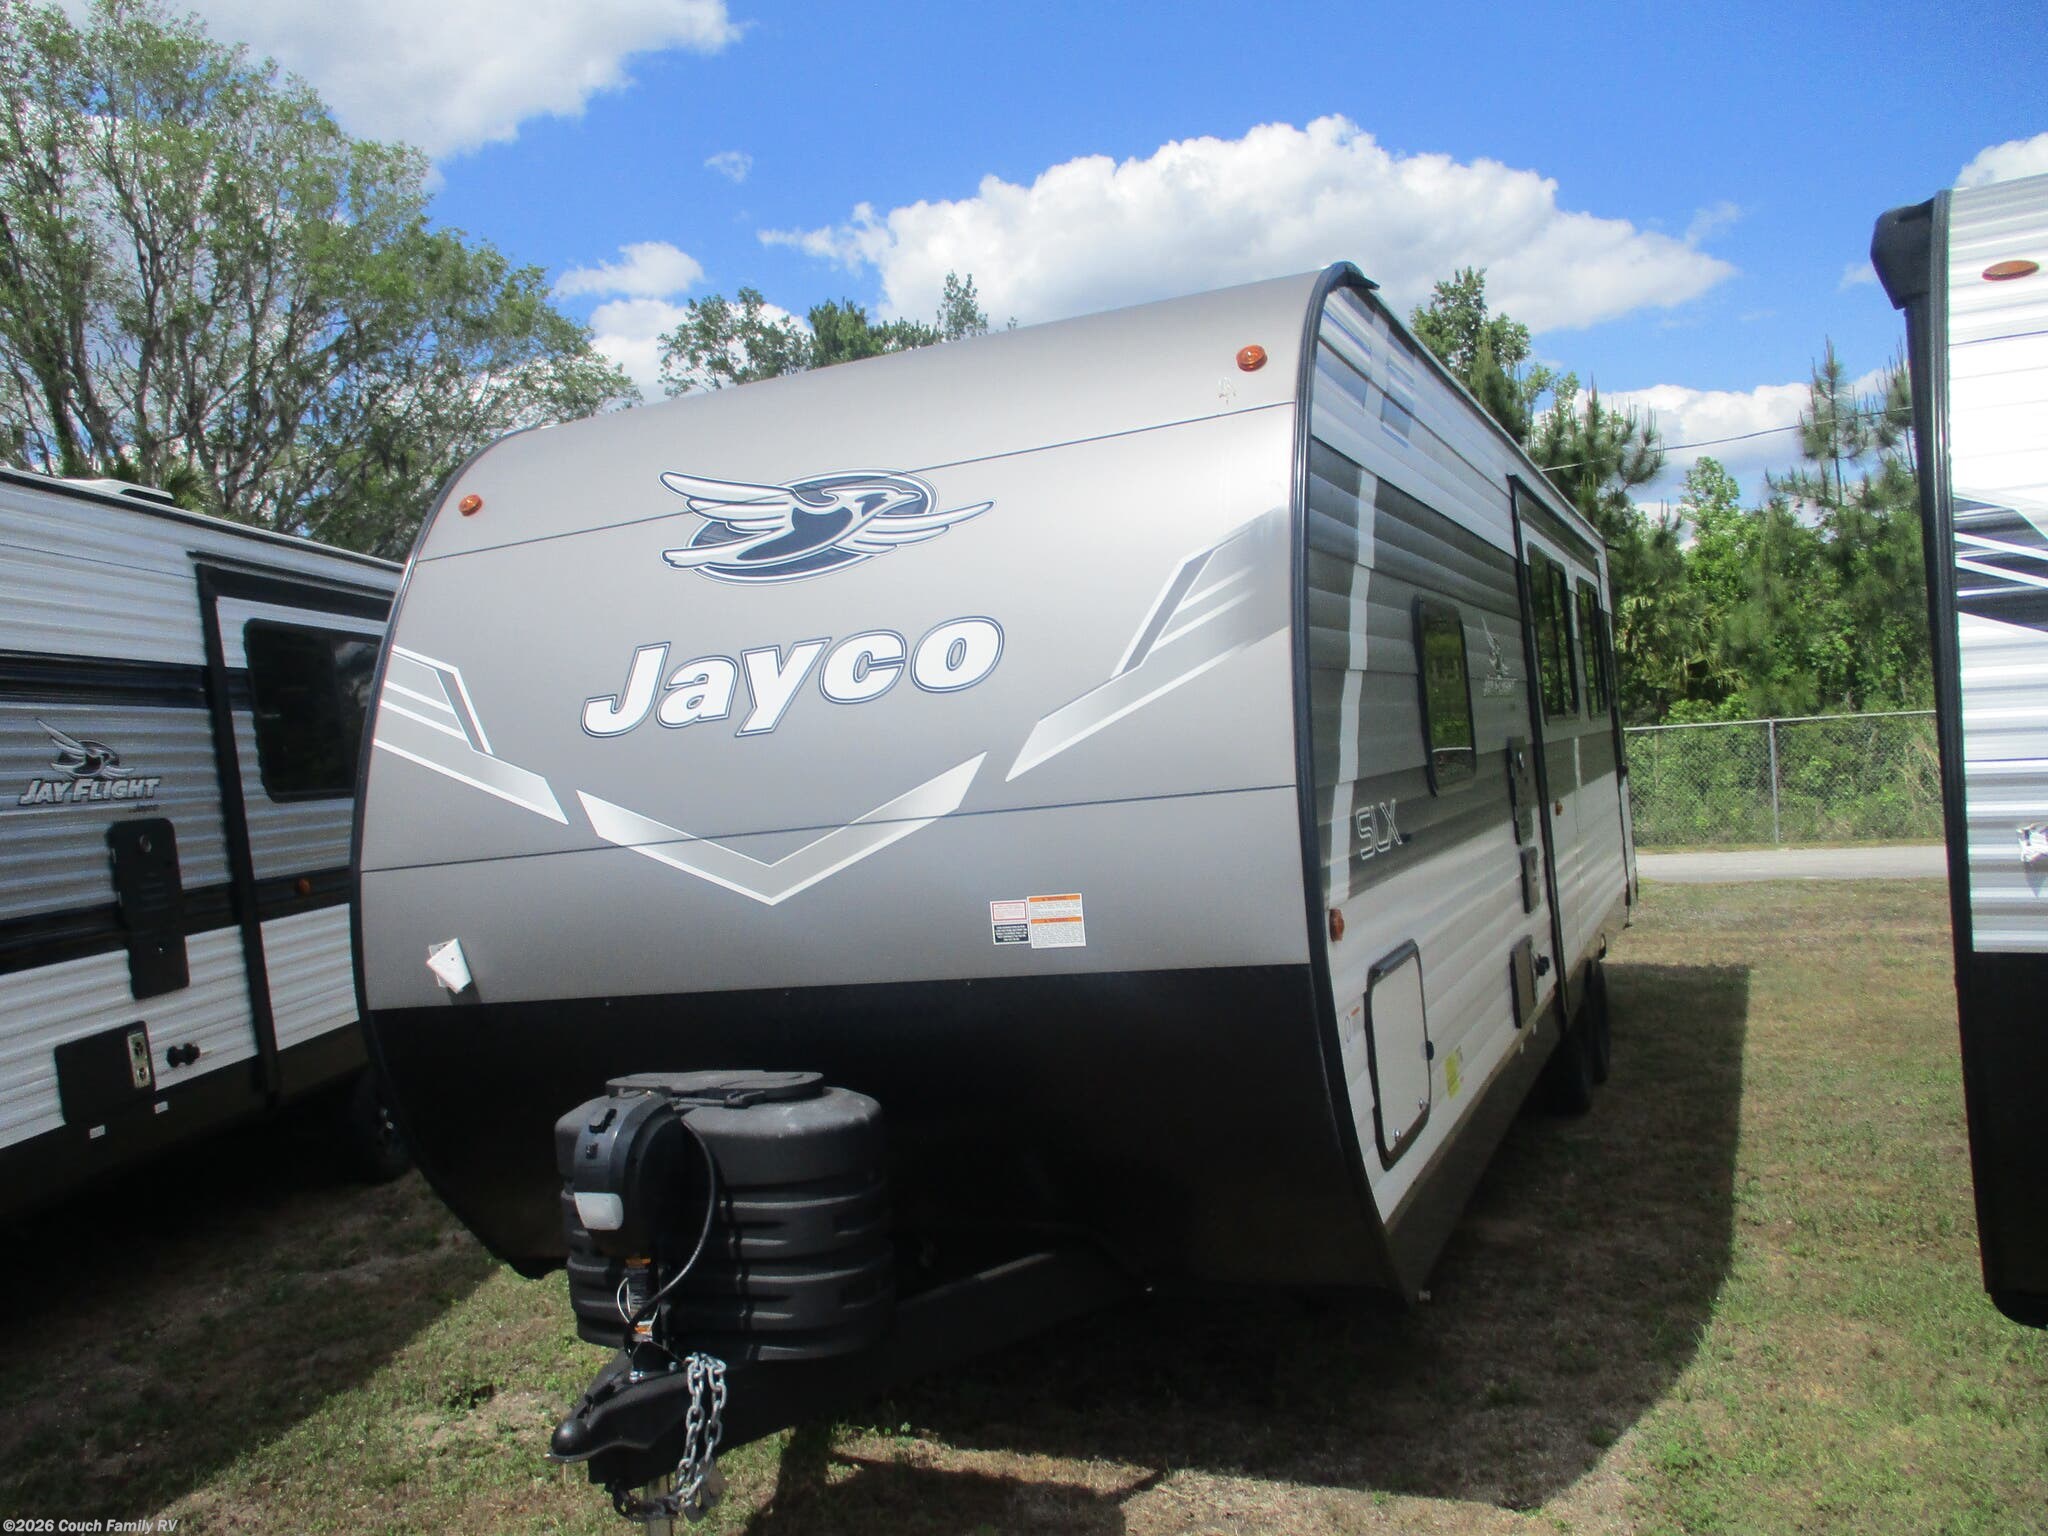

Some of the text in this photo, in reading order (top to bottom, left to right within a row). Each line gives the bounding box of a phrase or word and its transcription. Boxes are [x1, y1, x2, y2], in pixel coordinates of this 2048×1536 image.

[580, 615, 1005, 739] Jayco
[18, 776, 161, 806] JAY FLIGHT
[1355, 798, 1403, 860] SLX
